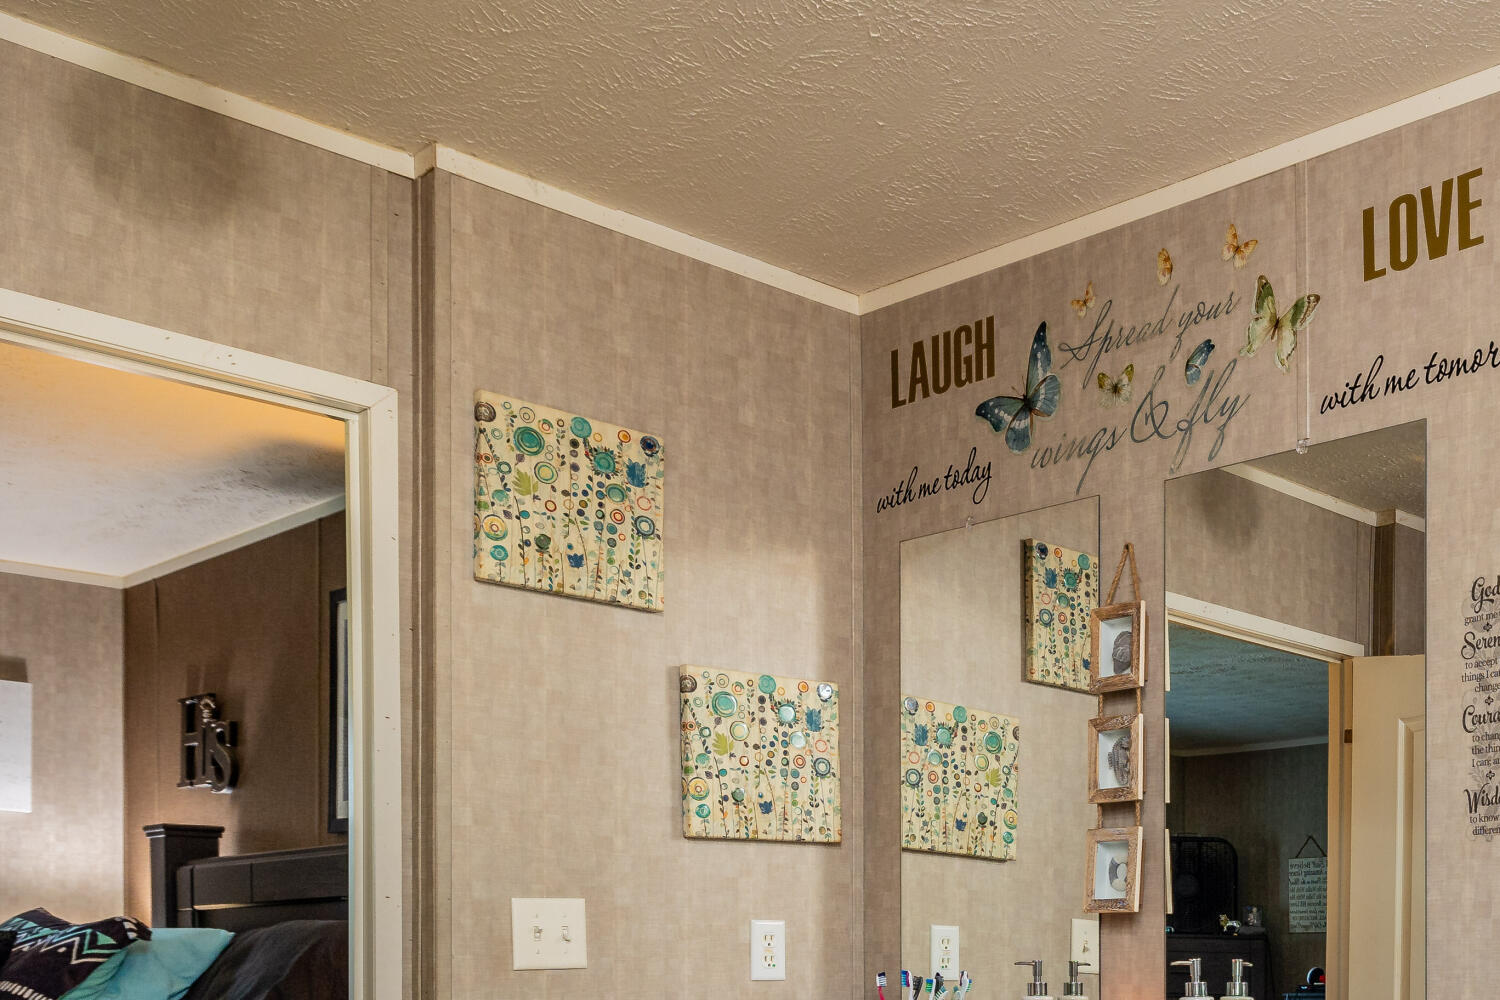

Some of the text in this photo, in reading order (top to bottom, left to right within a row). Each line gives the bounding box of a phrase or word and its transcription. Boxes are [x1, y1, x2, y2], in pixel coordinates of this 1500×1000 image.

[1363, 167, 1485, 282] LOVE
[1058, 284, 1241, 389] Spread your
[890, 315, 995, 409] LAUGH
[1320, 354, 1384, 415] with
[1384, 368, 1420, 396] me
[1030, 358, 1251, 495] wings & fly
[876, 447, 993, 513] with me today
[1471, 575, 1500, 613] God
[1464, 614, 1484, 626] grant
[1486, 612, 1498, 620] me
[1461, 672, 1485, 683] things
[1465, 661, 1473, 669] to
[1474, 658, 1498, 669] accept
[1471, 745, 1484, 755] the
[1472, 734, 1480, 743] to
[1469, 815, 1477, 824] to
[1478, 813, 1500, 823] know
